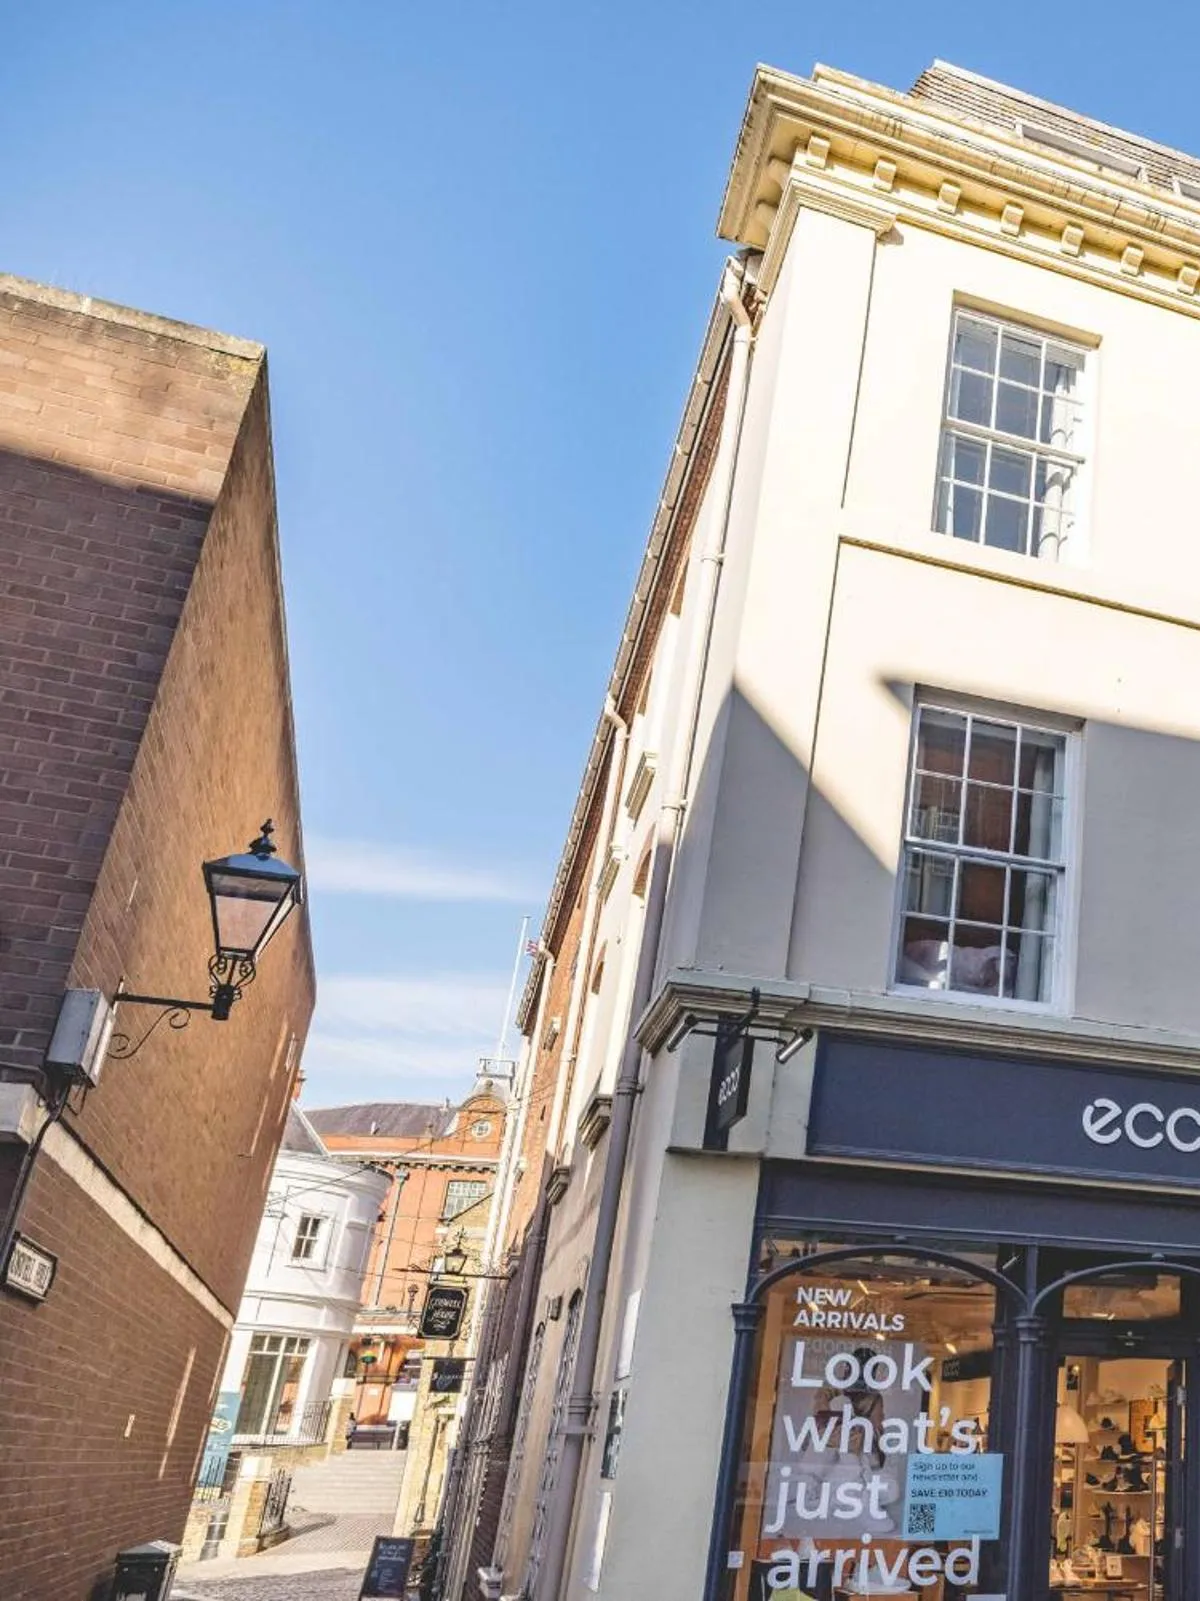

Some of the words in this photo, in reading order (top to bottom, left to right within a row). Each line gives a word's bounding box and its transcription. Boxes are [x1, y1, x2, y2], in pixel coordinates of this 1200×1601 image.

[797, 1286, 851, 1306] NEW
[793, 1310, 905, 1331] ARRIVALS
[792, 1341, 935, 1392] Look
[764, 1466, 888, 1533] just
[911, 1488, 936, 1498] SAVE
[956, 1488, 988, 1498] TODAY
[766, 1533, 980, 1588] arrived
